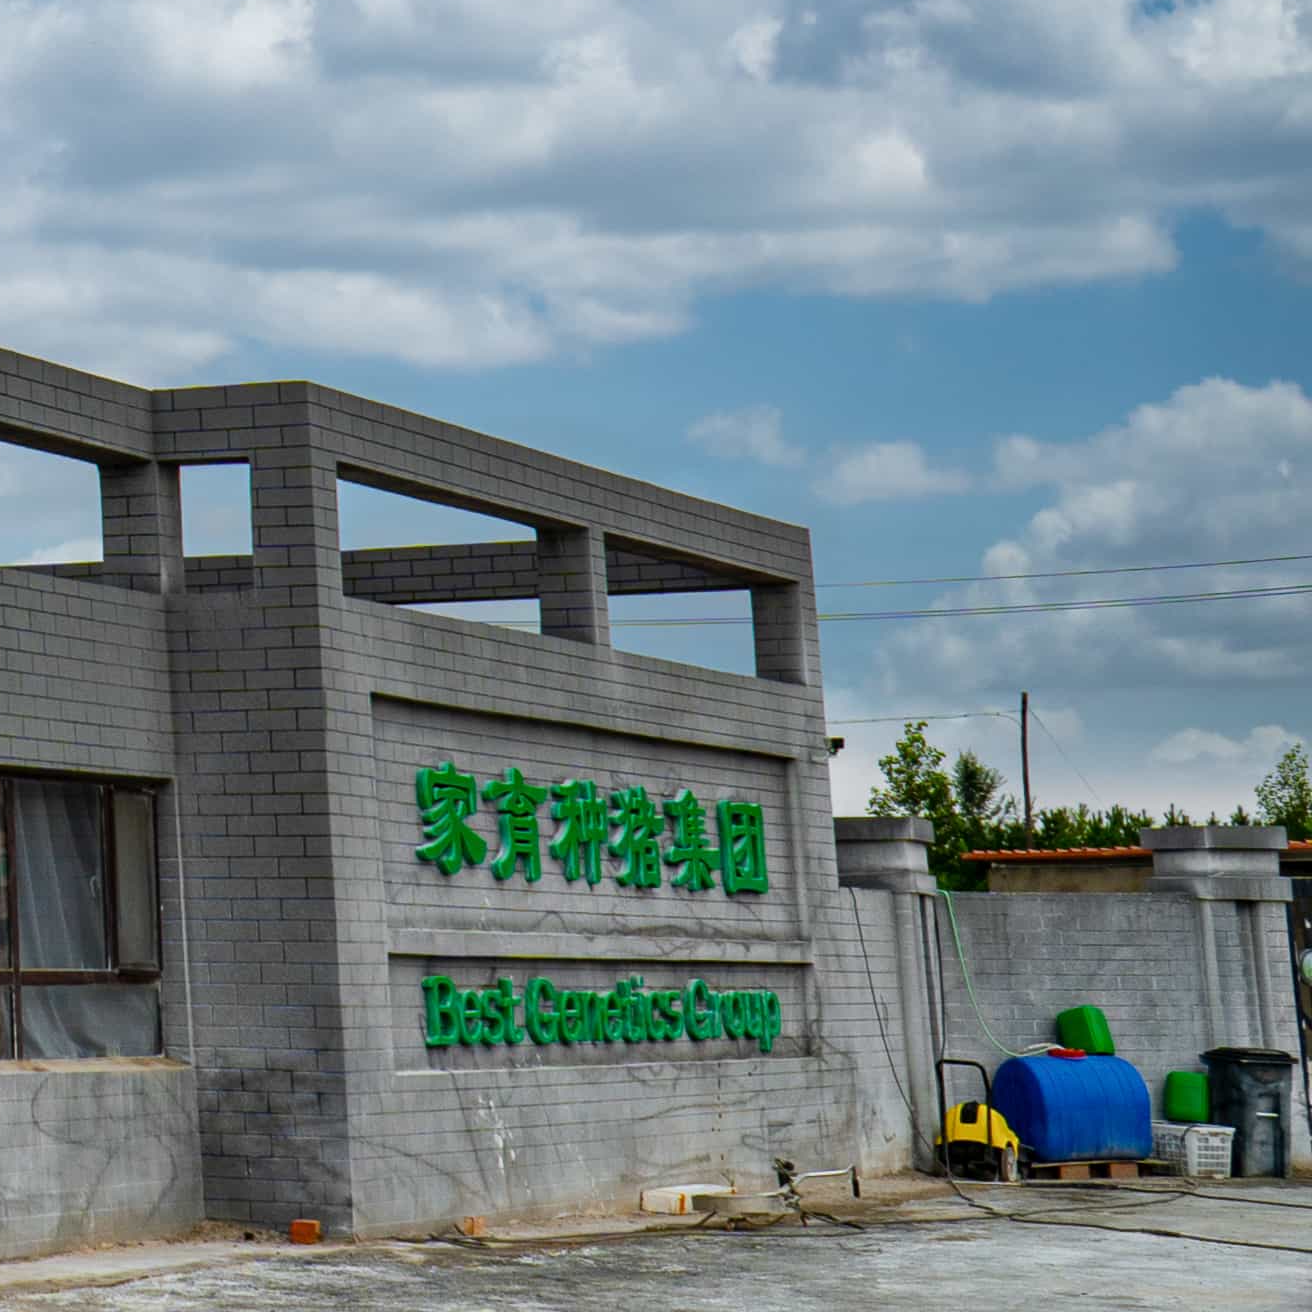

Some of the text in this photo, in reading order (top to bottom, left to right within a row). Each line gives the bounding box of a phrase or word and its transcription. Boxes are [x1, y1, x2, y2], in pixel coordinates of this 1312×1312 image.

[415, 761, 770, 896] 家育种猪集团
[421, 972, 782, 1053] Best Genetics Group
